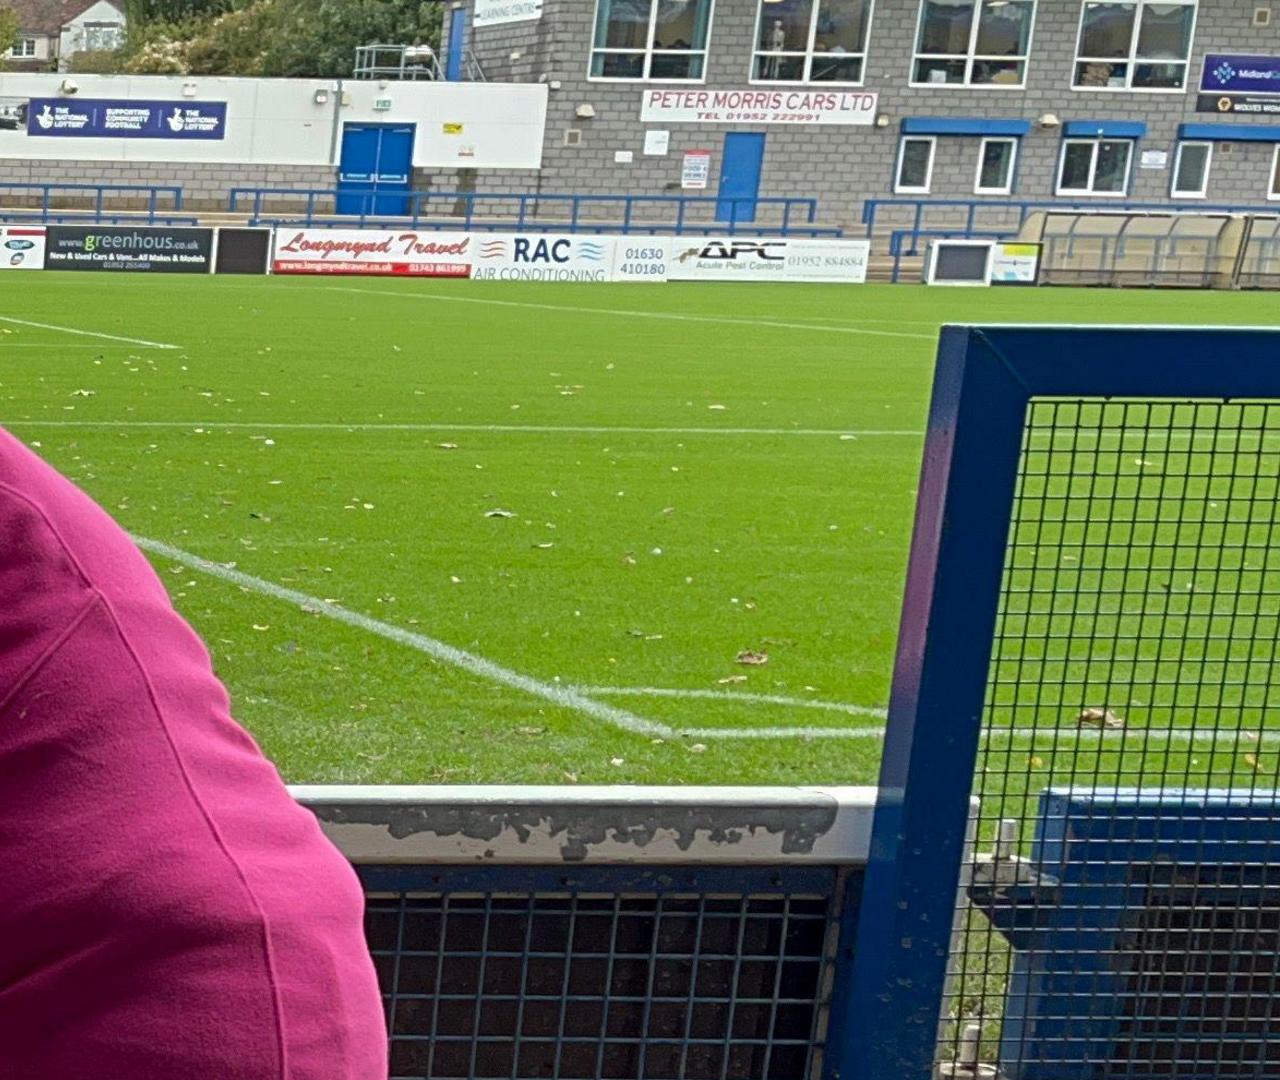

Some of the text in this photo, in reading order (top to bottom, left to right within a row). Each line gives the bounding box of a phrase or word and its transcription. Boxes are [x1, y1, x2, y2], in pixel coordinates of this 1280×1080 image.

[648, 91, 874, 112] PETER MORRIS CARS LTD
[696, 112, 821, 121] TEL 01952 222991
[58, 231, 199, 251] www.greenhous.co.uk
[280, 232, 471, 259] Longmynd Travel
[49, 252, 67, 260] New
[67, 252, 74, 260] &
[75, 252, 92, 260] Used
[92, 252, 108, 261] Cars
[108, 253, 115, 261] &
[149, 254, 171, 262] Makes
[172, 254, 179, 262] &
[180, 255, 206, 263] Models
[513, 238, 572, 263] RAC
[625, 248, 664, 259] 01630
[698, 241, 787, 260] APC
[620, 263, 666, 275] 410180
[696, 261, 785, 270] Acute Pest Control
[474, 267, 605, 282] AIR CONDITIONING
